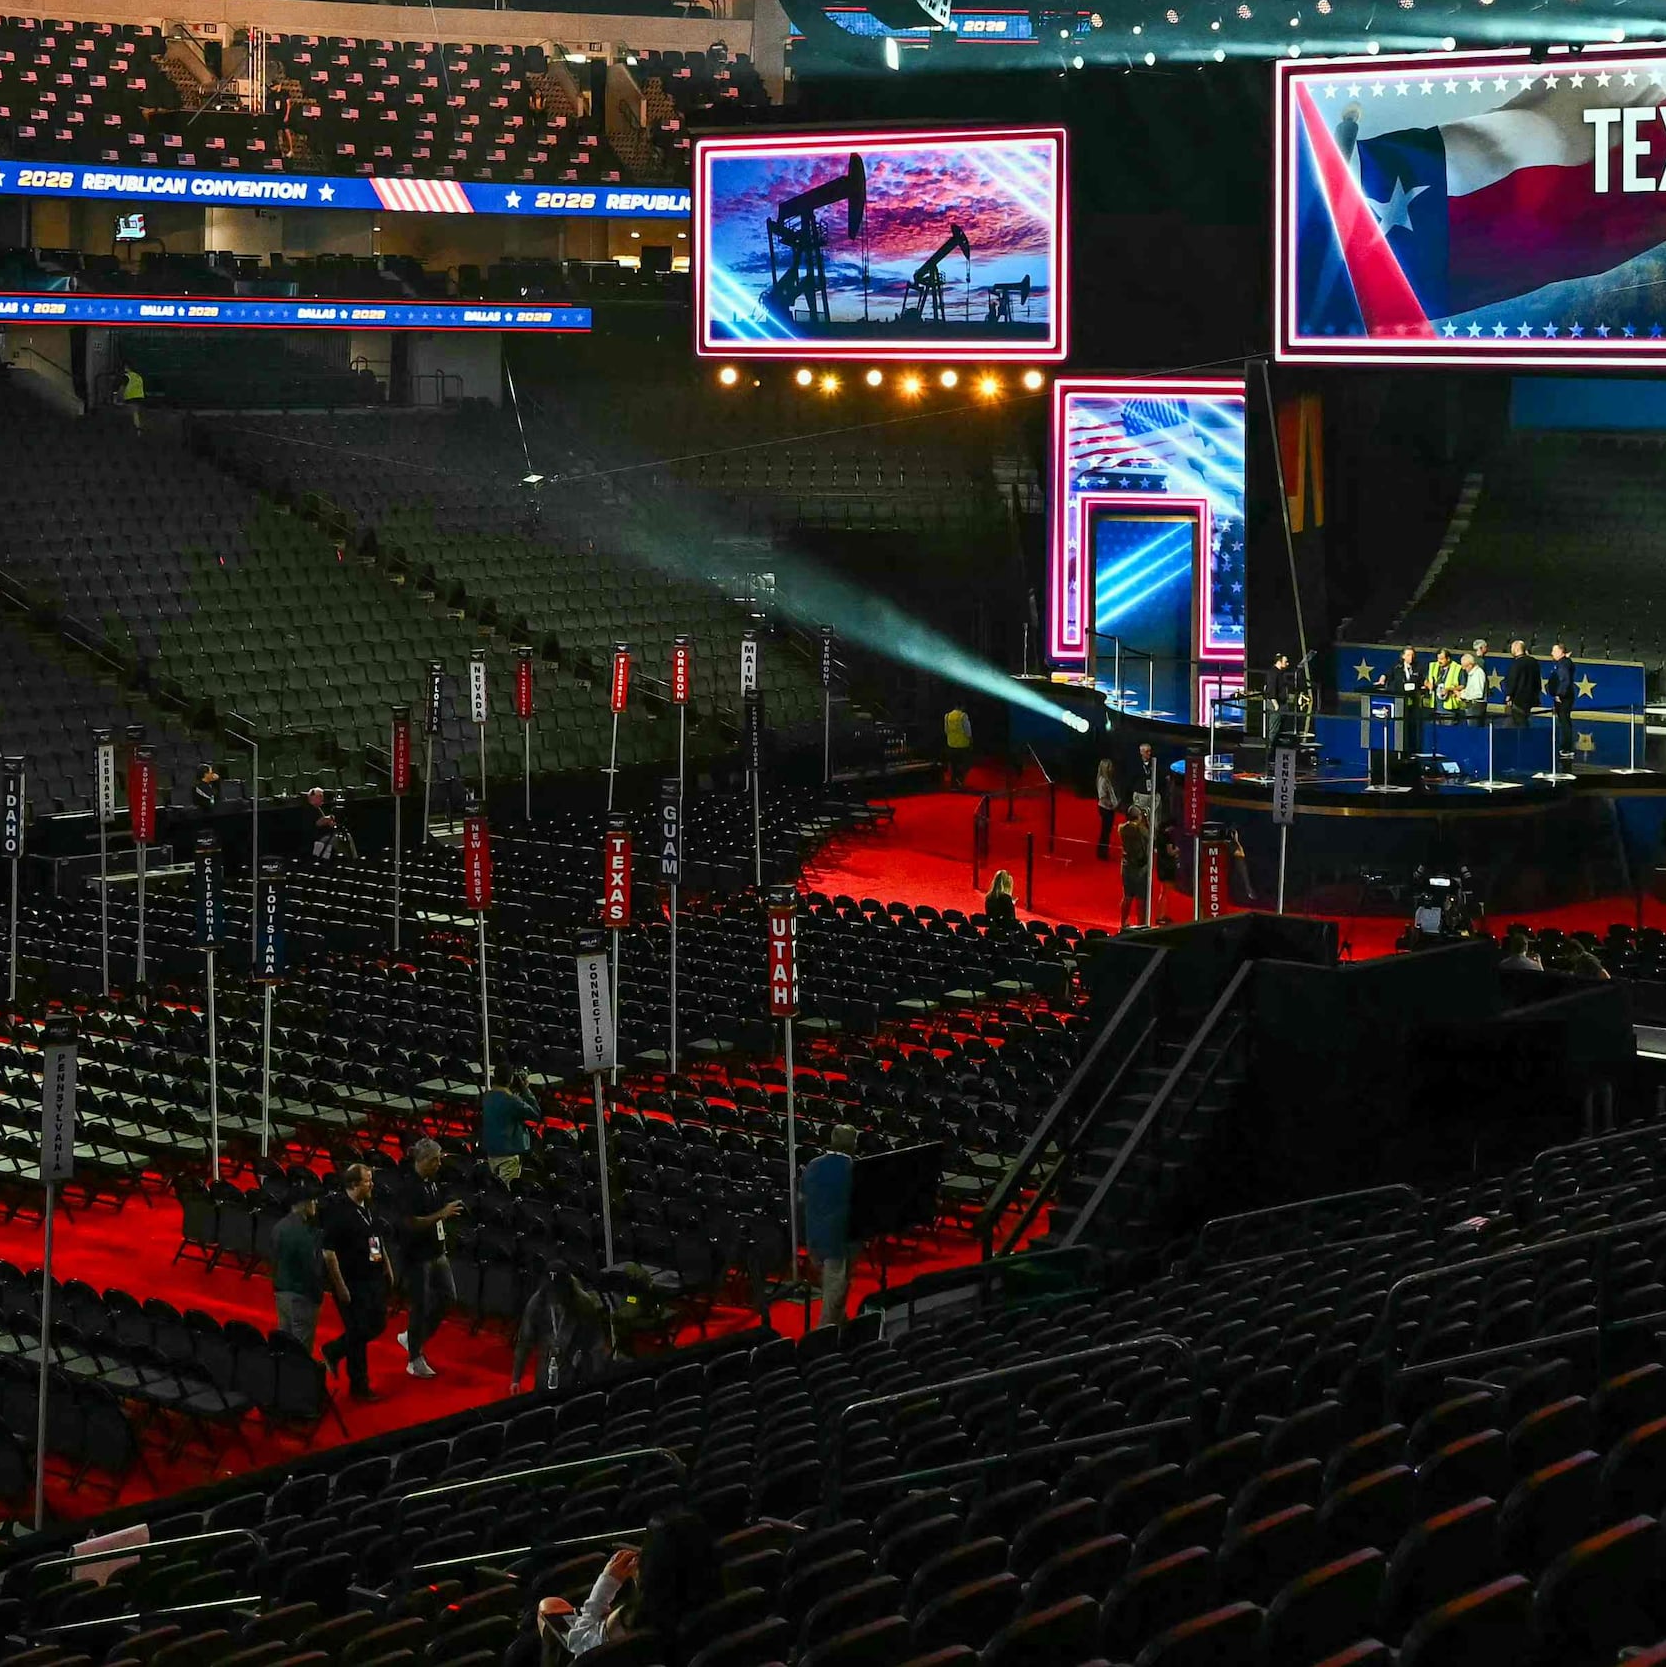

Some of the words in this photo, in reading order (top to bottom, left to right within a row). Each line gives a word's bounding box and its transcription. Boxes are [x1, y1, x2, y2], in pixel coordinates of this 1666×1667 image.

[17, 170, 75, 189] 2026
[81, 173, 187, 195] REPUBLICAN
[190, 178, 309, 200] CONVENTION
[535, 192, 597, 210] 2026
[432, 676, 441, 732] FLORIDA
[474, 665, 483, 721] NEVADA
[676, 648, 684, 700] OREGON
[4, 779, 17, 852] IDAHO
[103, 750, 111, 818] NEBRASKA
[1279, 753, 1289, 818] KENTUCKY
[470, 823, 482, 849] NEW
[661, 804, 678, 875] GUAM
[203, 857, 215, 942] CALIFORNIA
[472, 853, 483, 903] JERSEY
[609, 838, 625, 920] TEXAS
[1208, 847, 1219, 917] MINNESOT
[264, 884, 278, 974] LOUISIANA
[771, 918, 787, 1005] UTAH
[790, 916, 799, 1005] UTAH
[589, 962, 603, 1062] CONNECTICUT
[53, 1053, 65, 1172] PENNSYLVANIA
